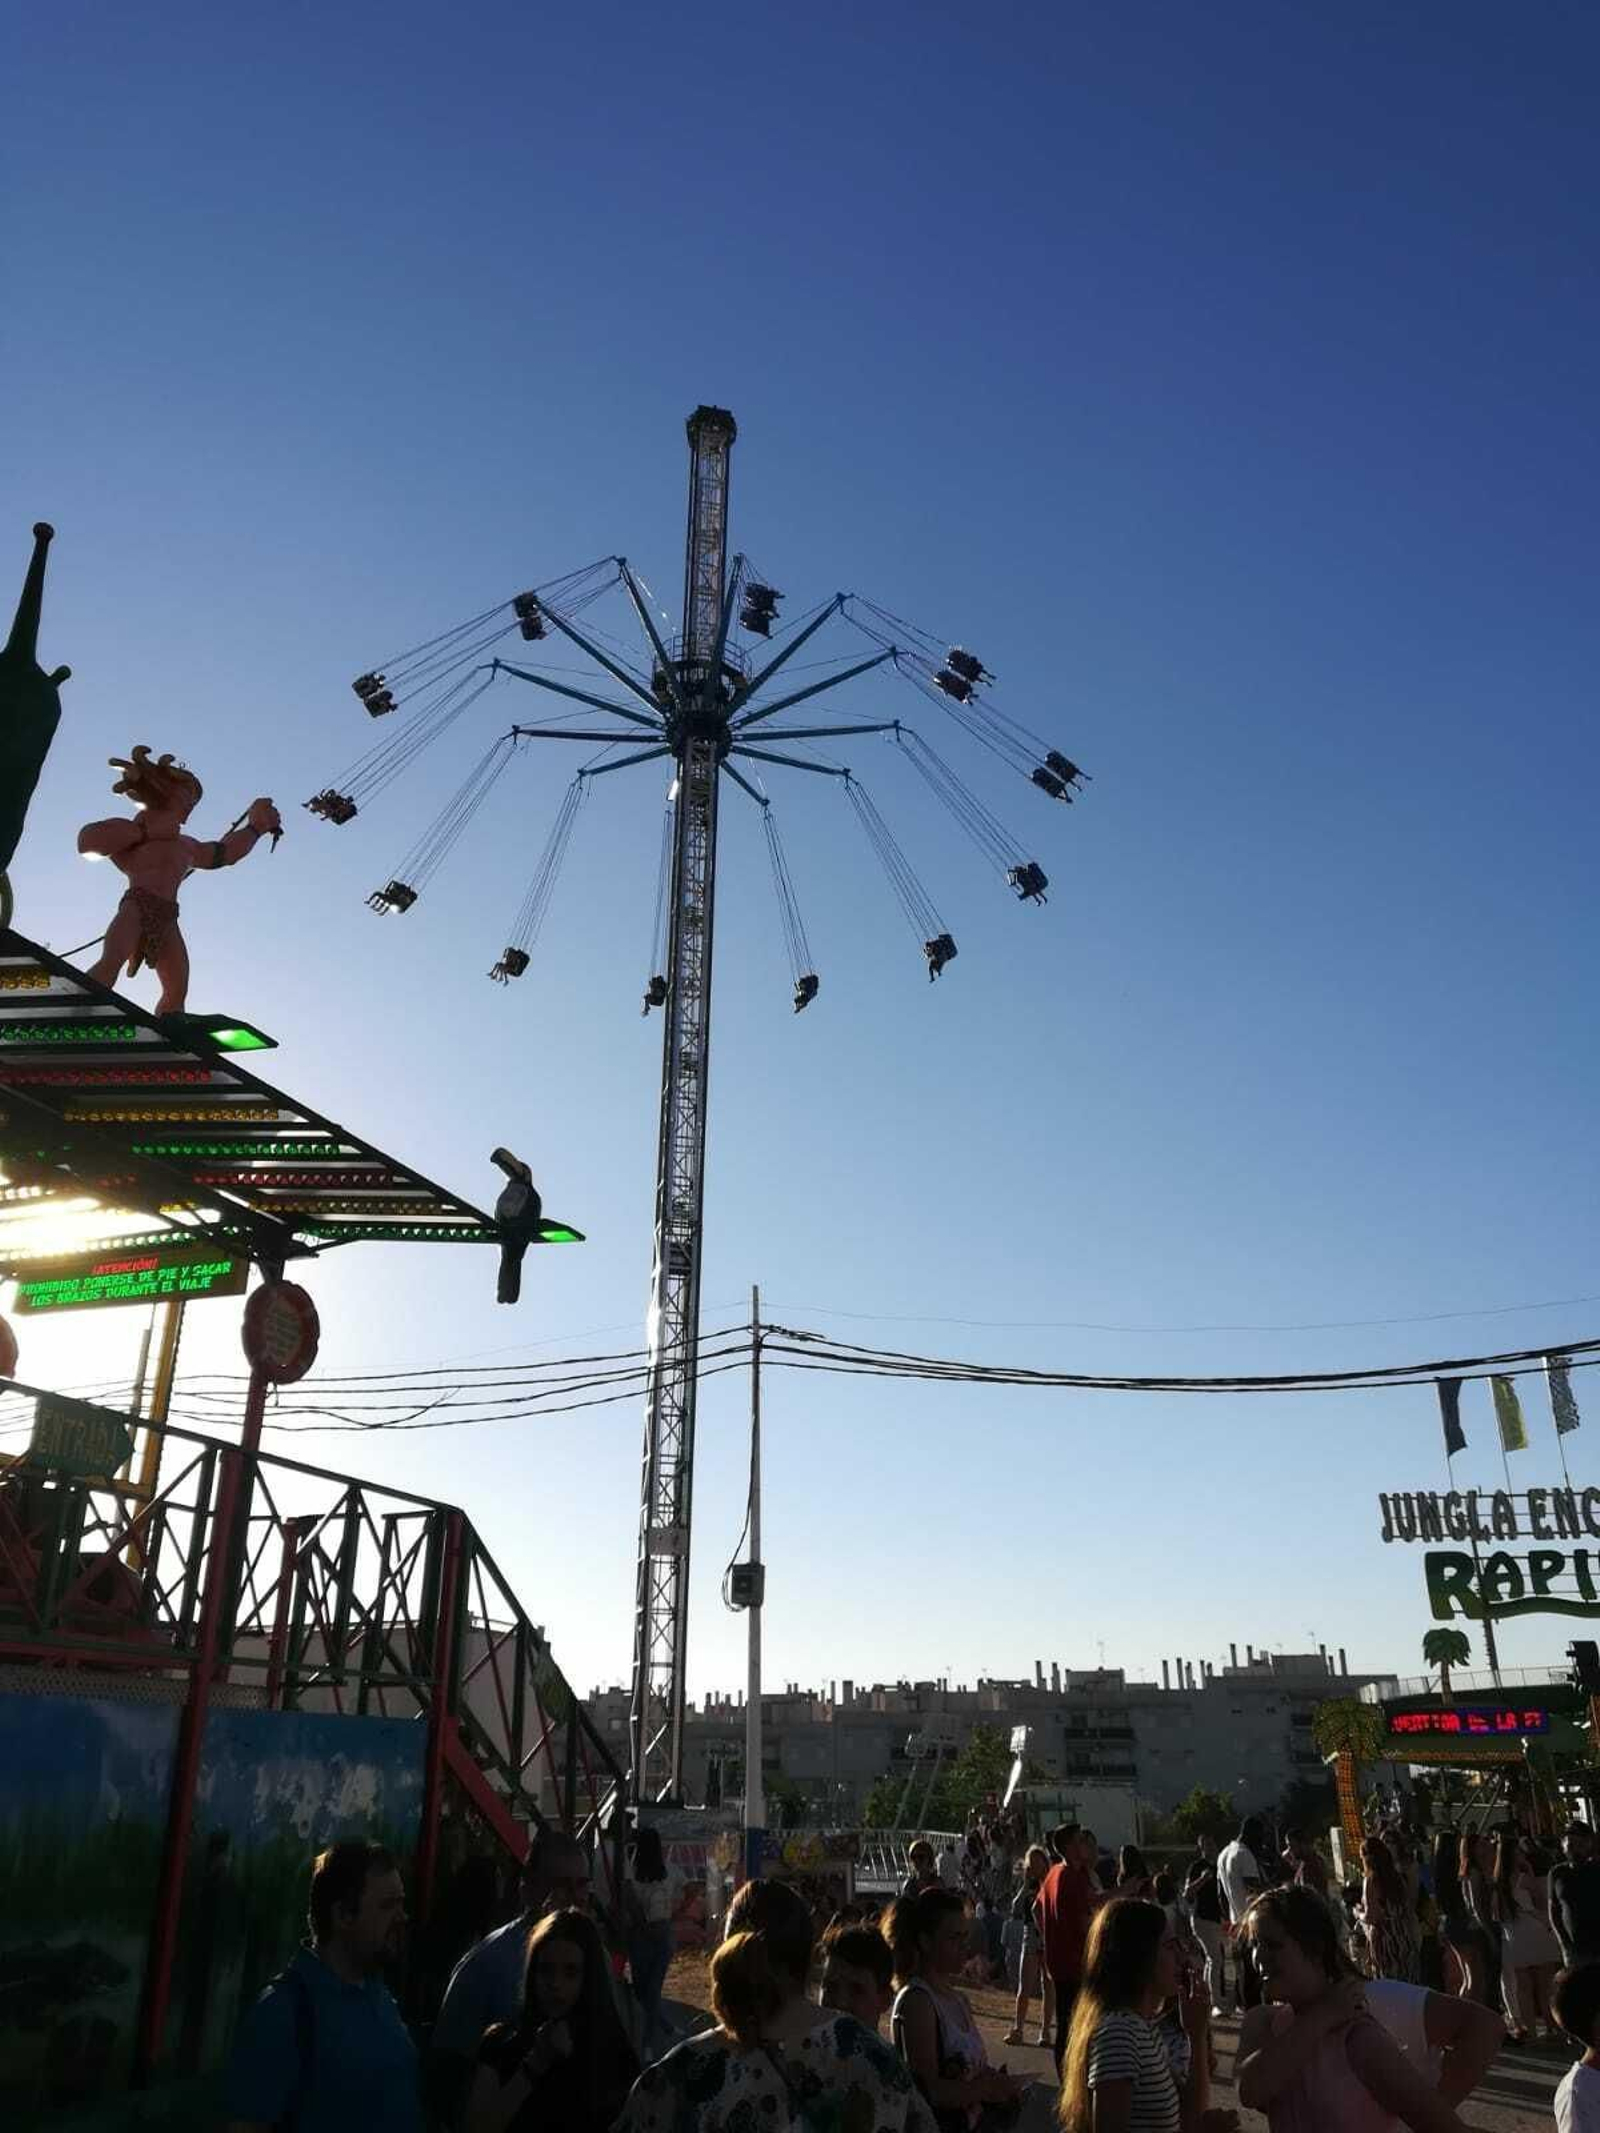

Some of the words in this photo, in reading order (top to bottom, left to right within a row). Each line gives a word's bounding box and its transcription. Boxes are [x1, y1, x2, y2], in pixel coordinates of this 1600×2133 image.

[31, 1293, 56, 1308] LOS
[105, 1281, 158, 1300] DURANTE
[161, 1280, 174, 1293] EL
[179, 1276, 212, 1291] VIAJE
[83, 1272, 135, 1290] PONERSE
[137, 1269, 156, 1283] DE
[157, 1266, 178, 1280] PIE
[181, 1265, 189, 1278] Y
[191, 1261, 232, 1277] SACAR
[1379, 1489, 1517, 1543] JUNGLA
[1425, 1549, 1600, 1620] RAPI
